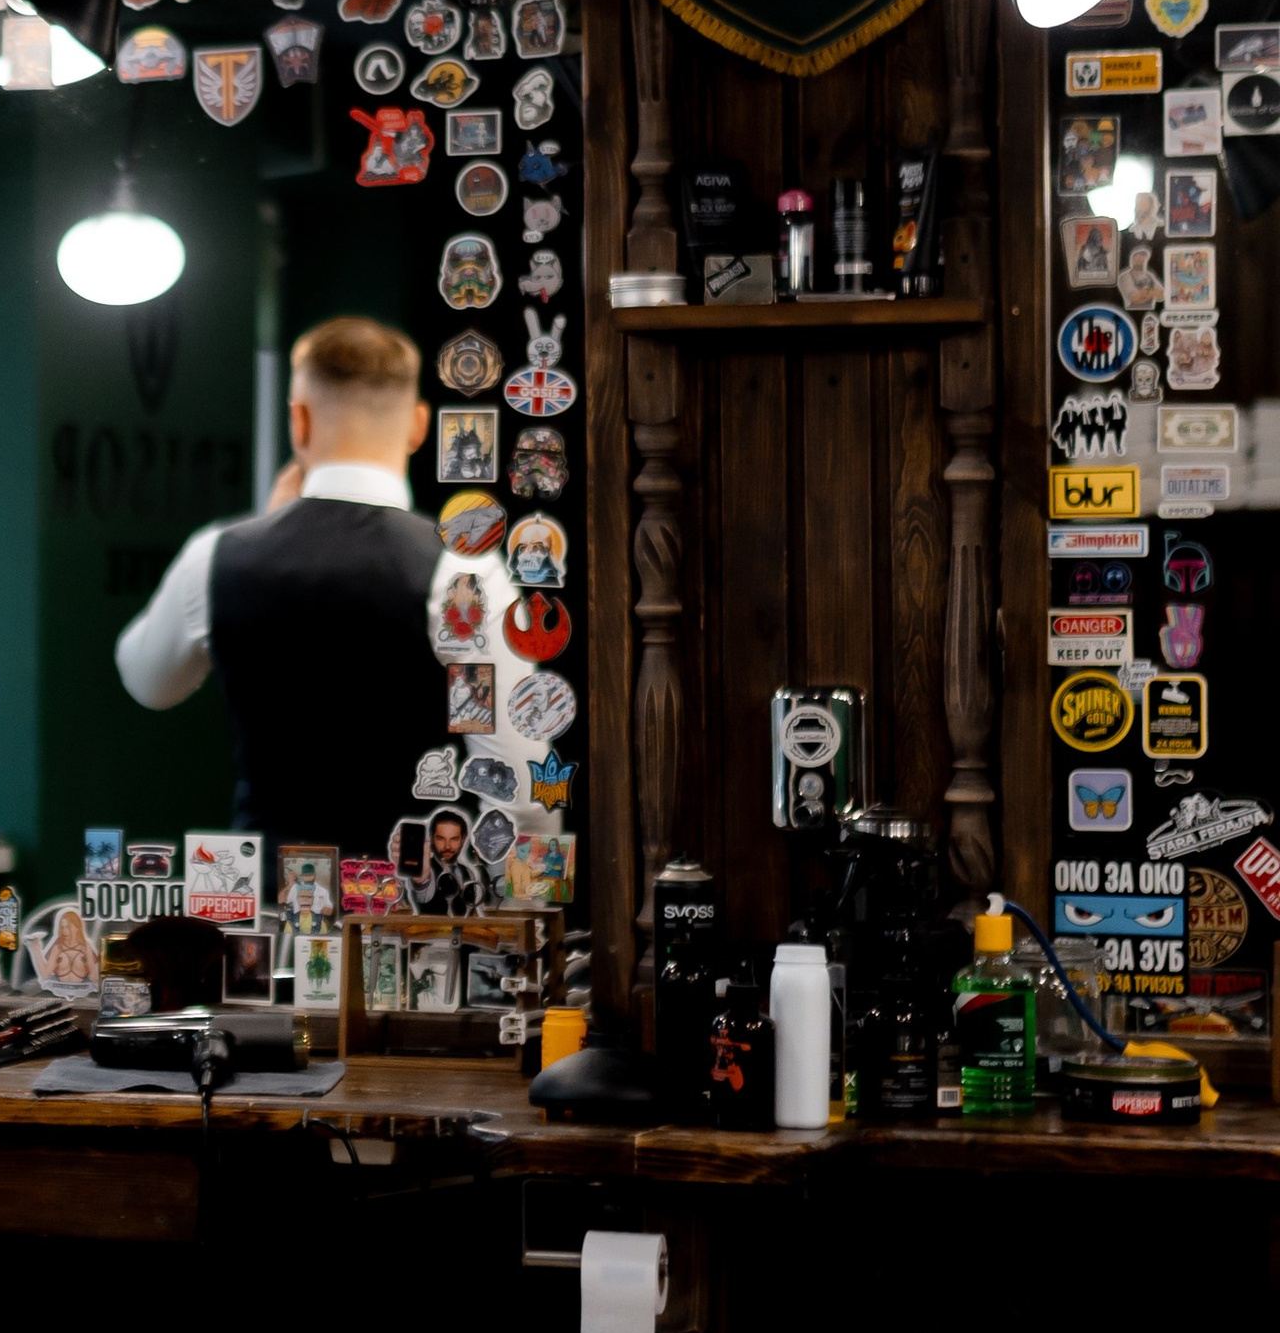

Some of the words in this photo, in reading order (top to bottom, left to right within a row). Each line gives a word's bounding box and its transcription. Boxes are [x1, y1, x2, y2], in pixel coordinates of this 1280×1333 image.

[695, 174, 731, 187] AGIVA
[708, 261, 747, 293] PRORASO
[1064, 477, 1124, 507] blur
[1167, 479, 1222, 495] OUTATIME
[1059, 619, 1117, 634] DANGER
[1053, 639, 1105, 648] CONSTRUCTION
[1108, 639, 1126, 647] AREA
[1057, 649, 1089, 660] KEEP
[1095, 648, 1122, 660] OUT
[1062, 688, 1121, 727] SHINER
[1086, 712, 1115, 726] GOLD
[1156, 739, 1168, 748] 24
[1148, 832, 1197, 860] STARA
[1198, 810, 1271, 844] FERAJNA
[1054, 859, 1099, 893] ОКО
[1104, 861, 1134, 894] ЗА
[1139, 861, 1184, 895] ОКО
[190, 896, 256, 915] UPPERCUT
[1104, 937, 1134, 971] ЗА
[1139, 939, 1185, 973] ЗУБ
[1133, 974, 1185, 995] ТРИЗУБ
[1112, 1096, 1162, 1112] UPPERCUT
